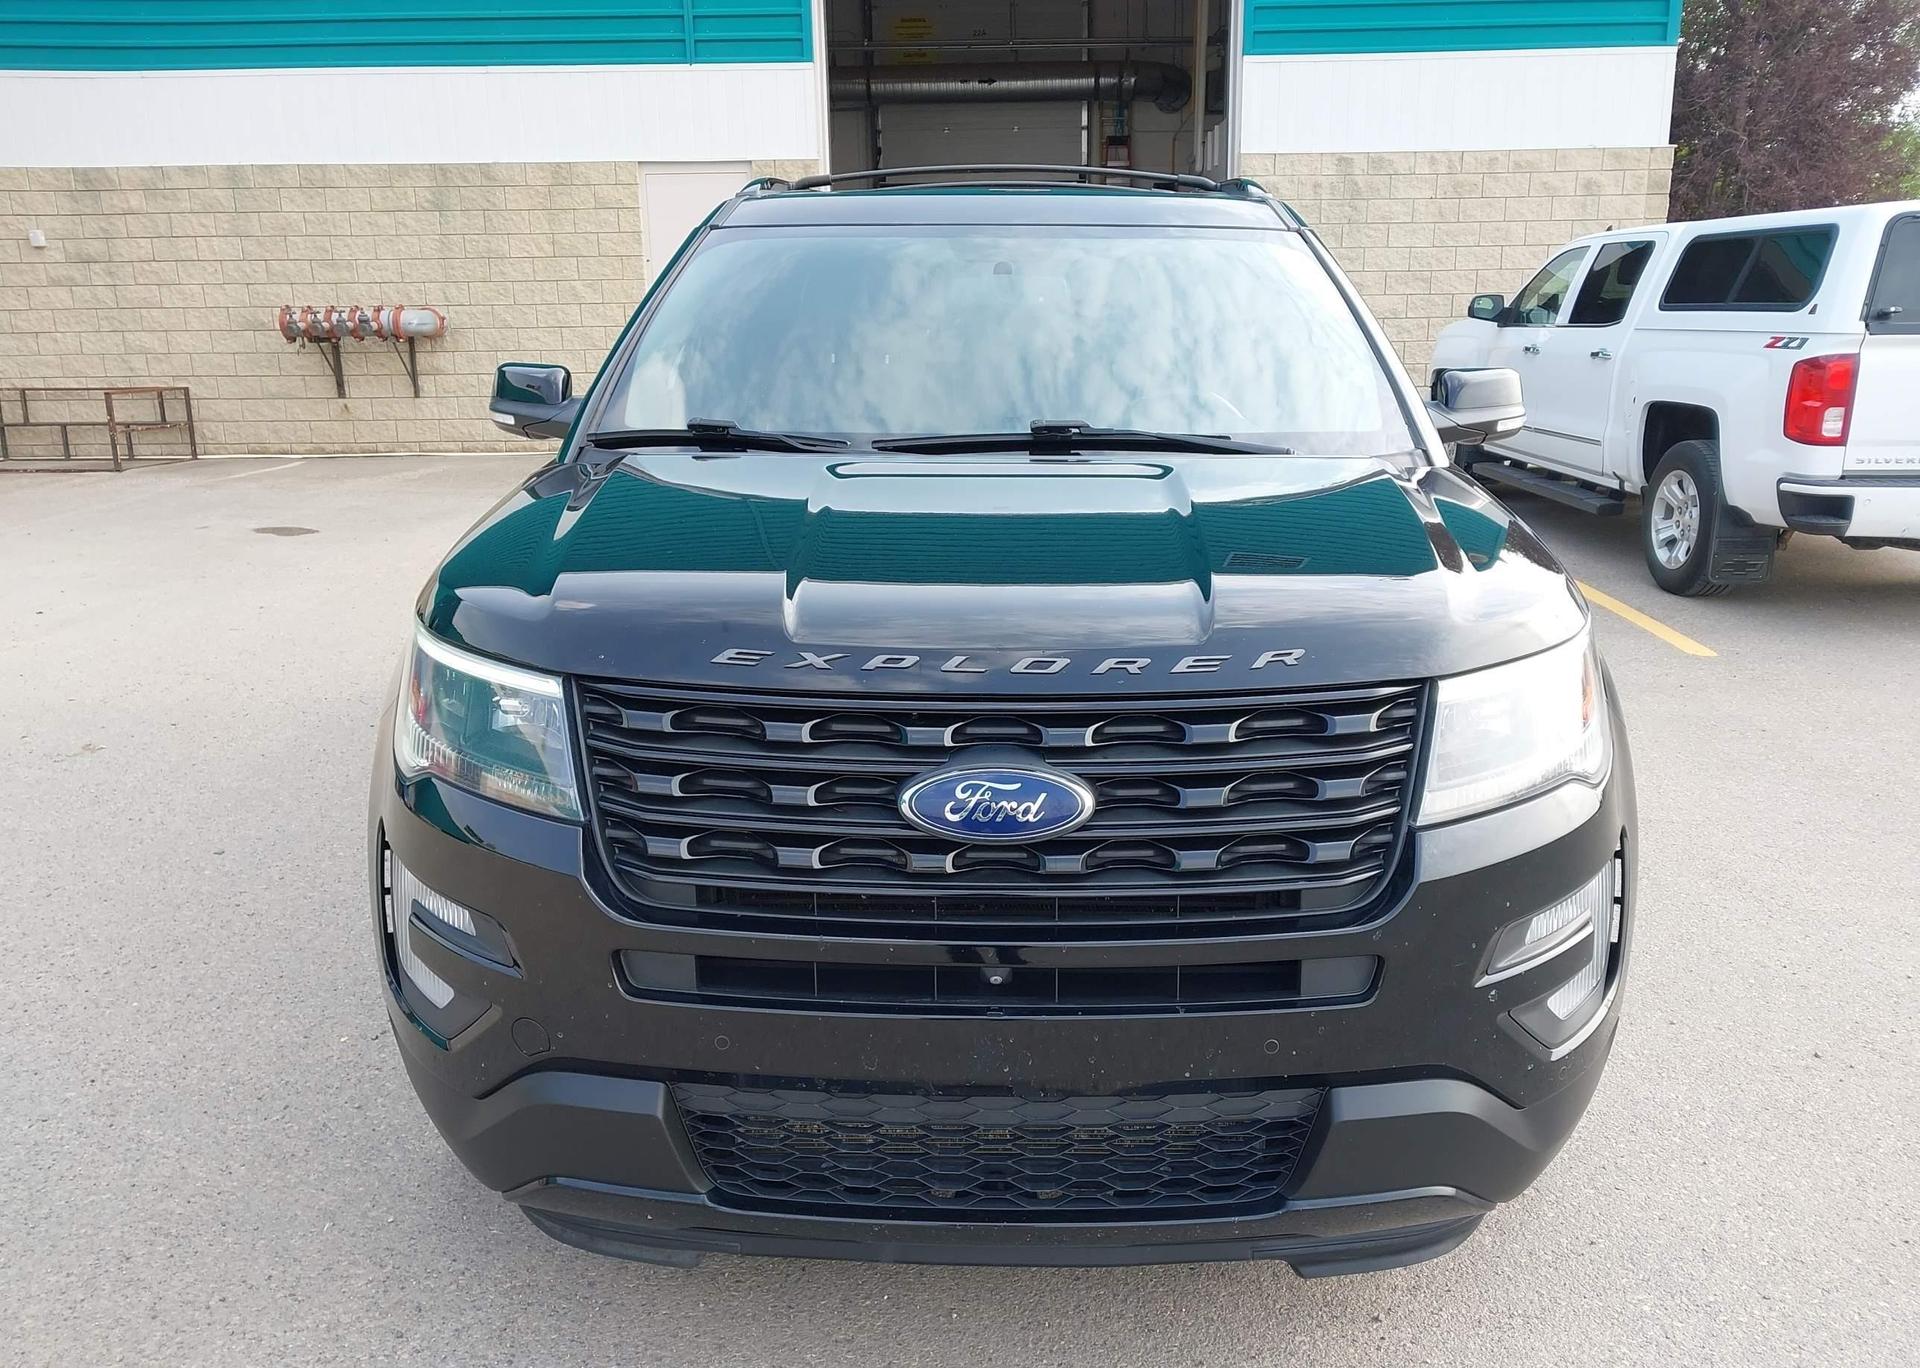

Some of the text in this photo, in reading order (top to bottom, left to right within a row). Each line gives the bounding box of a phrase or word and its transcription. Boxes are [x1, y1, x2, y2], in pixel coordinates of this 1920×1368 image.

[1763, 336, 1810, 351] Z71
[1855, 457, 1920, 465] SILVER
[709, 647, 1306, 675] EXPLORER
[943, 780, 1048, 823] Ford
